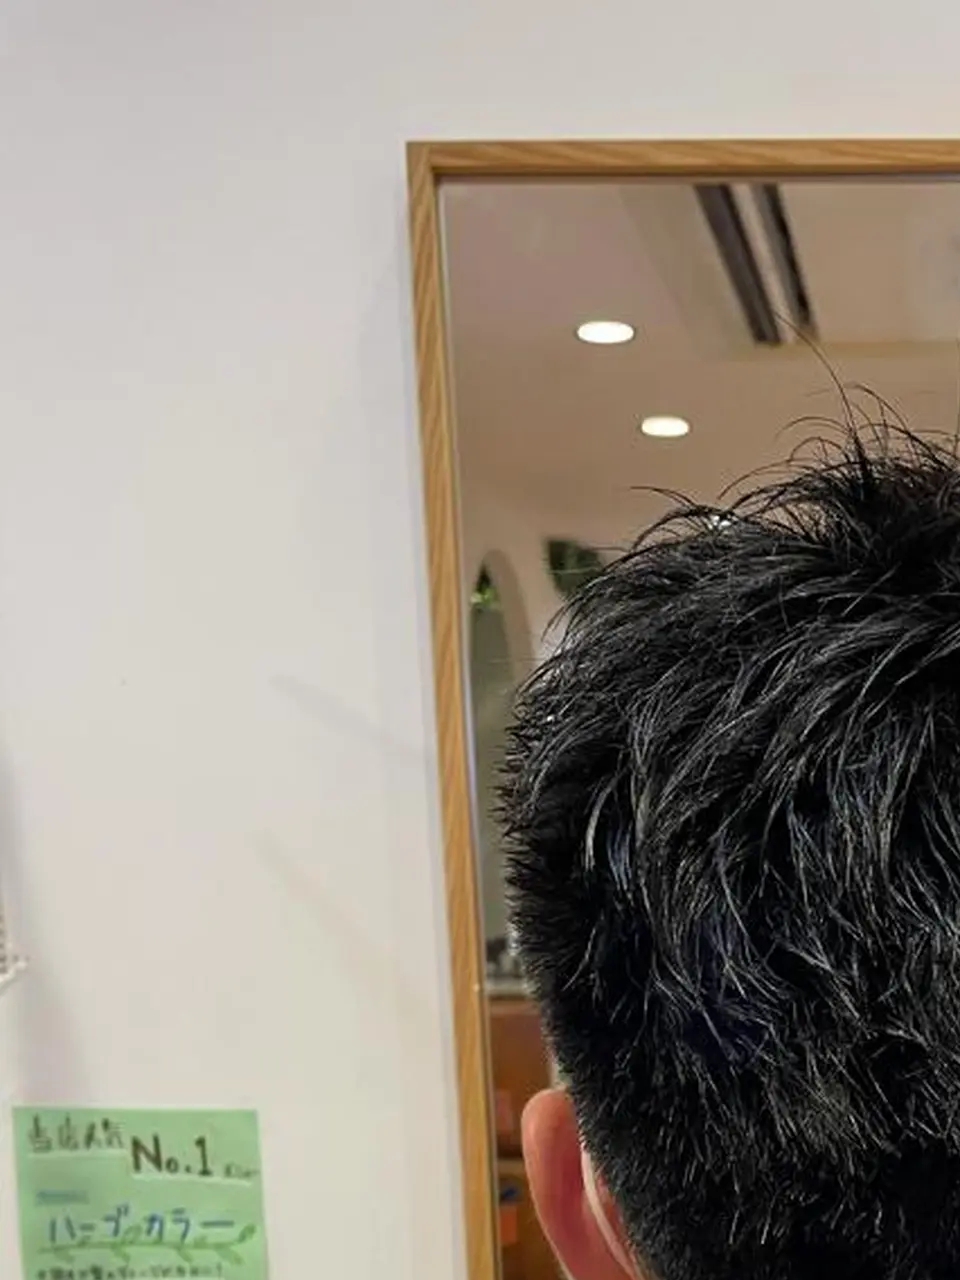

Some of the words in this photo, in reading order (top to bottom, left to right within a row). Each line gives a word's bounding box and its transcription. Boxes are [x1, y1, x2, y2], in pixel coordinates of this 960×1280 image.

[130, 1132, 212, 1177] No.1
[48, 1204, 235, 1244] ハーブカラー
